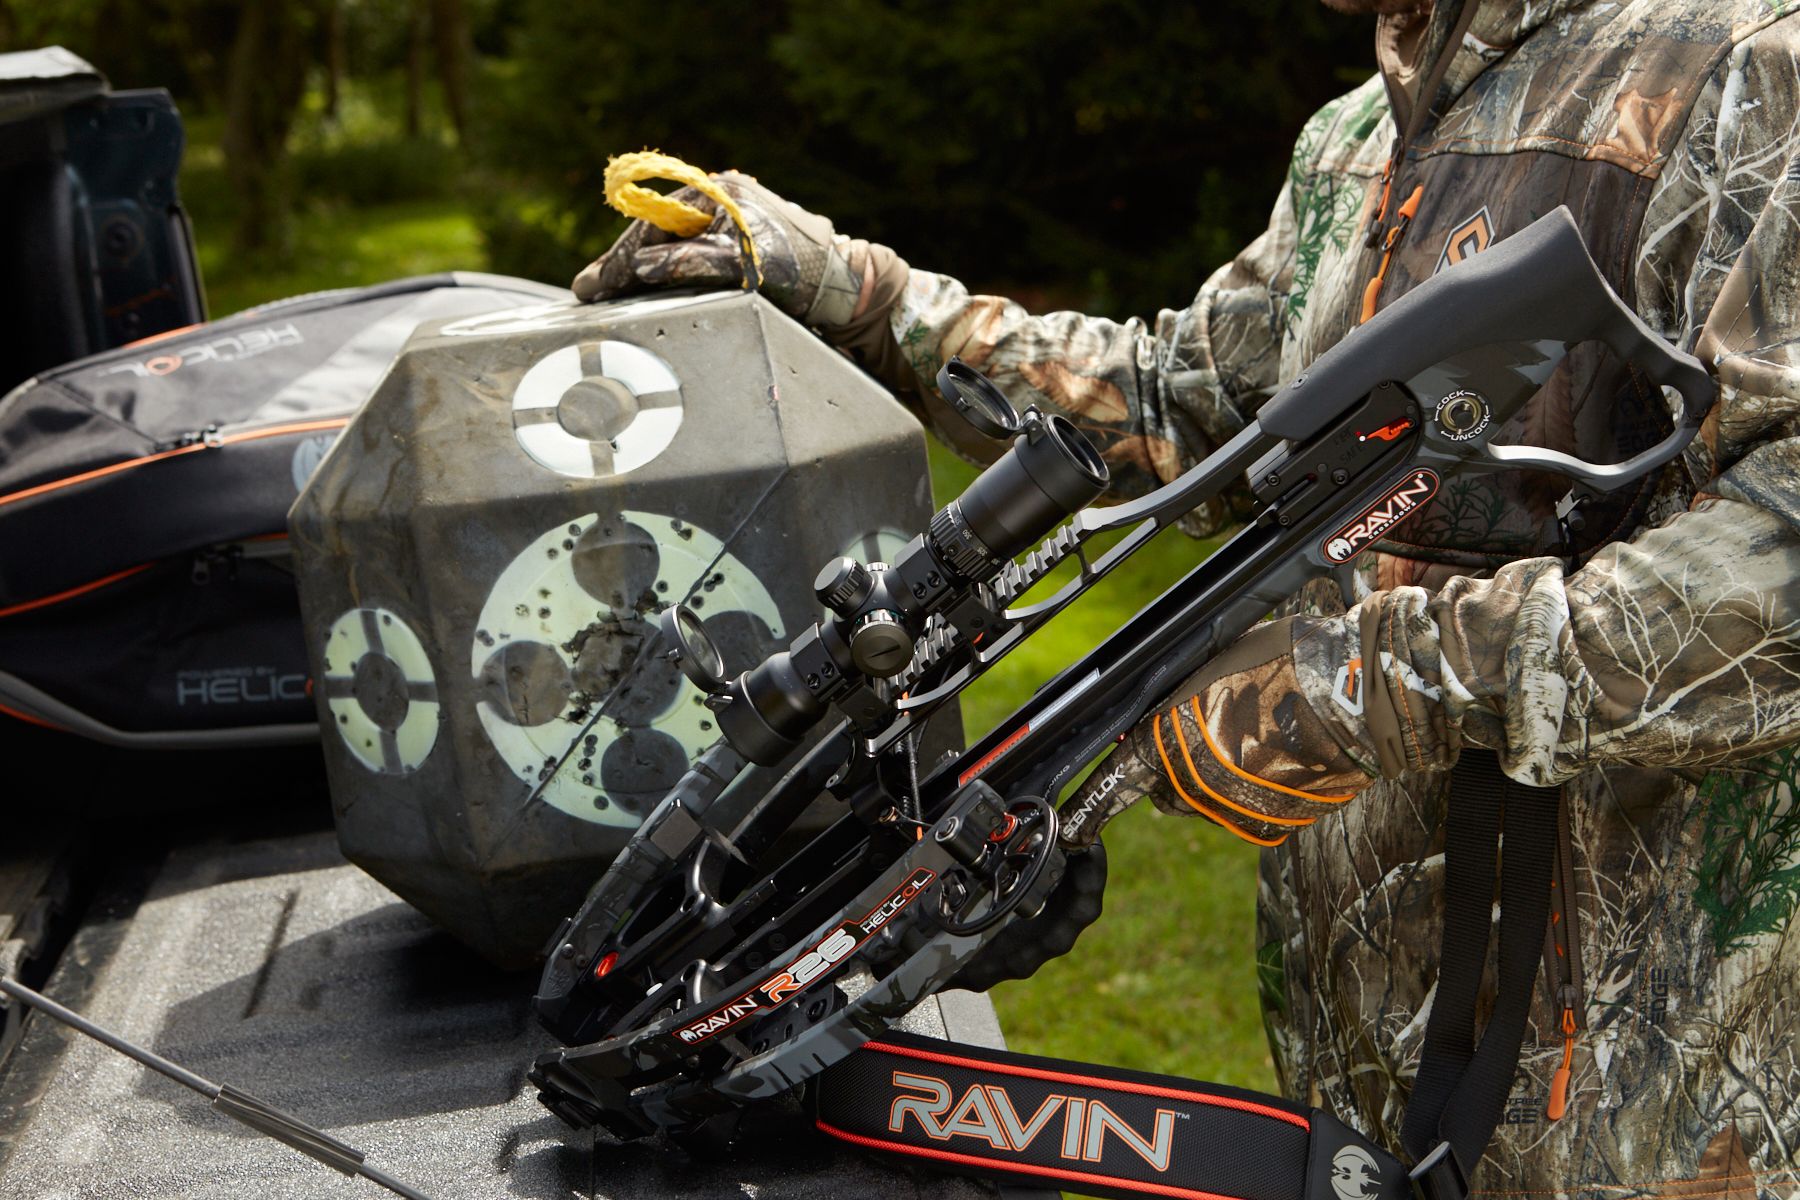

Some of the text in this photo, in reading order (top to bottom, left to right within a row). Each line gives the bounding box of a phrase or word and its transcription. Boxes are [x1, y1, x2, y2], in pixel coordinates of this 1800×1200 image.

[1437, 389, 1465, 411] COCK
[1451, 414, 1491, 442] UNCOCK
[1368, 501, 1417, 540] CROSSBOWS
[760, 928, 856, 1003] R26
[861, 874, 933, 934] HELICOIL
